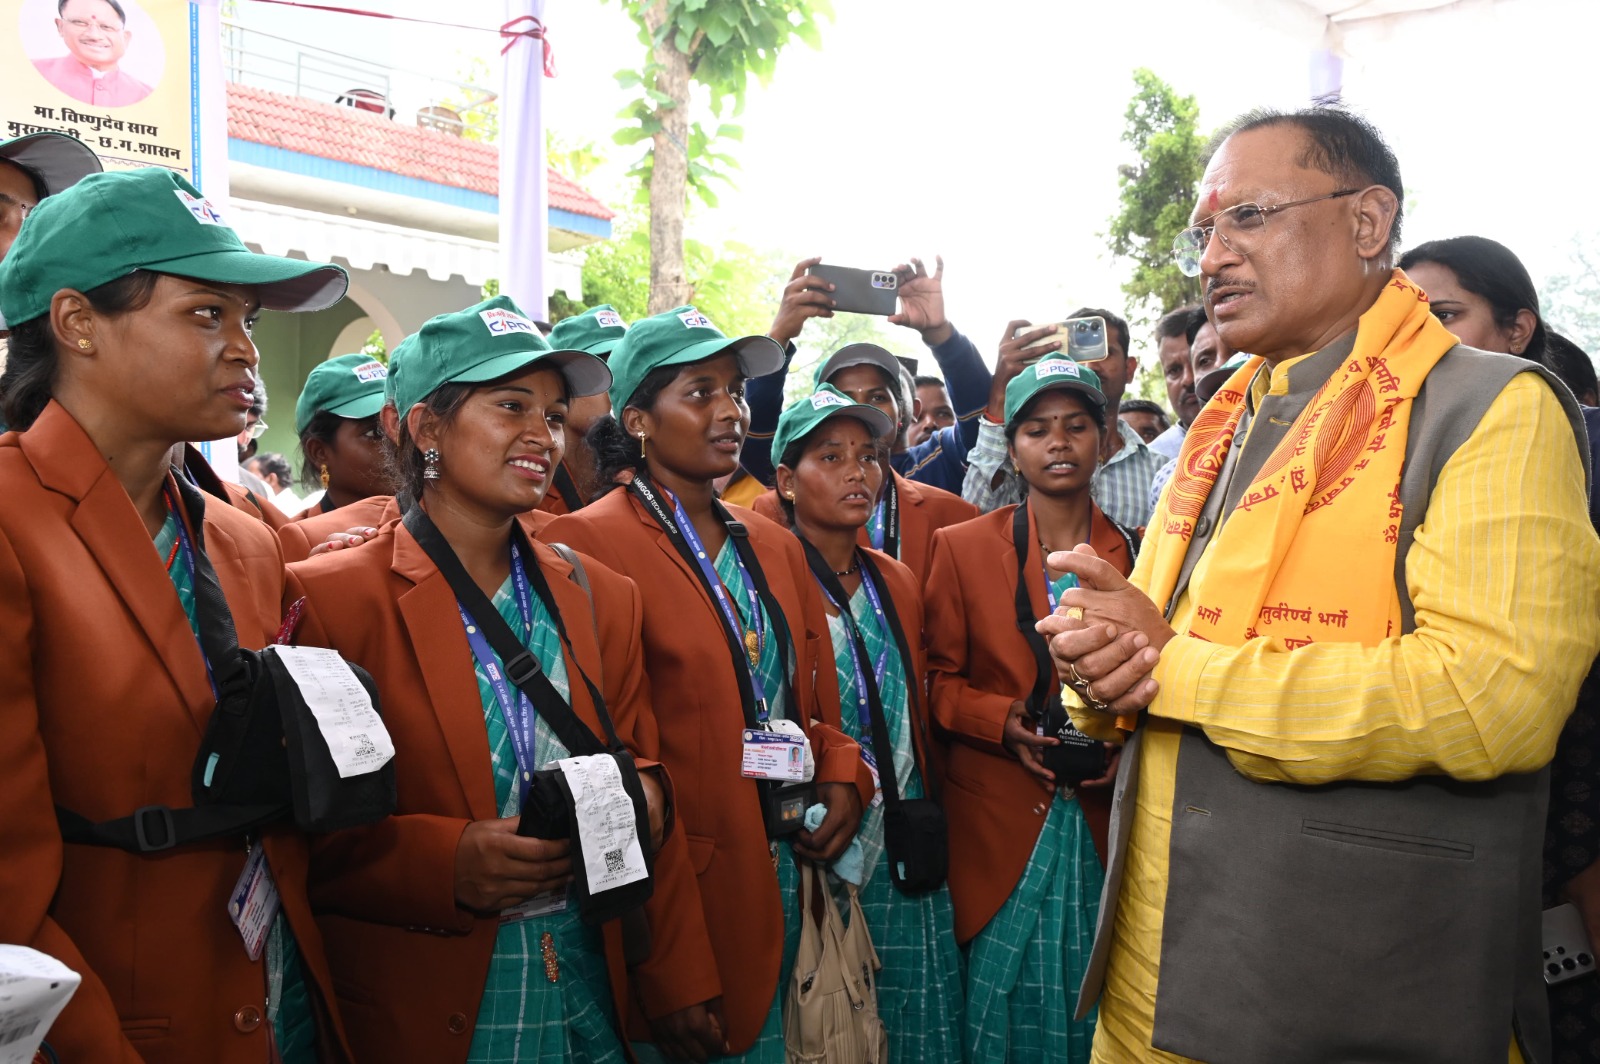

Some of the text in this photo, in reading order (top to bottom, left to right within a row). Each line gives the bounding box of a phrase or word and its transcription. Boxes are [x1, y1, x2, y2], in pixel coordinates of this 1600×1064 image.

[33, 105, 159, 137] मा.विष्णुदेव साय
[99, 136, 181, 160] छ.ग.शासन
[1197, 605, 1223, 626] भर्गो
[1318, 609, 1349, 628] भर्गो
